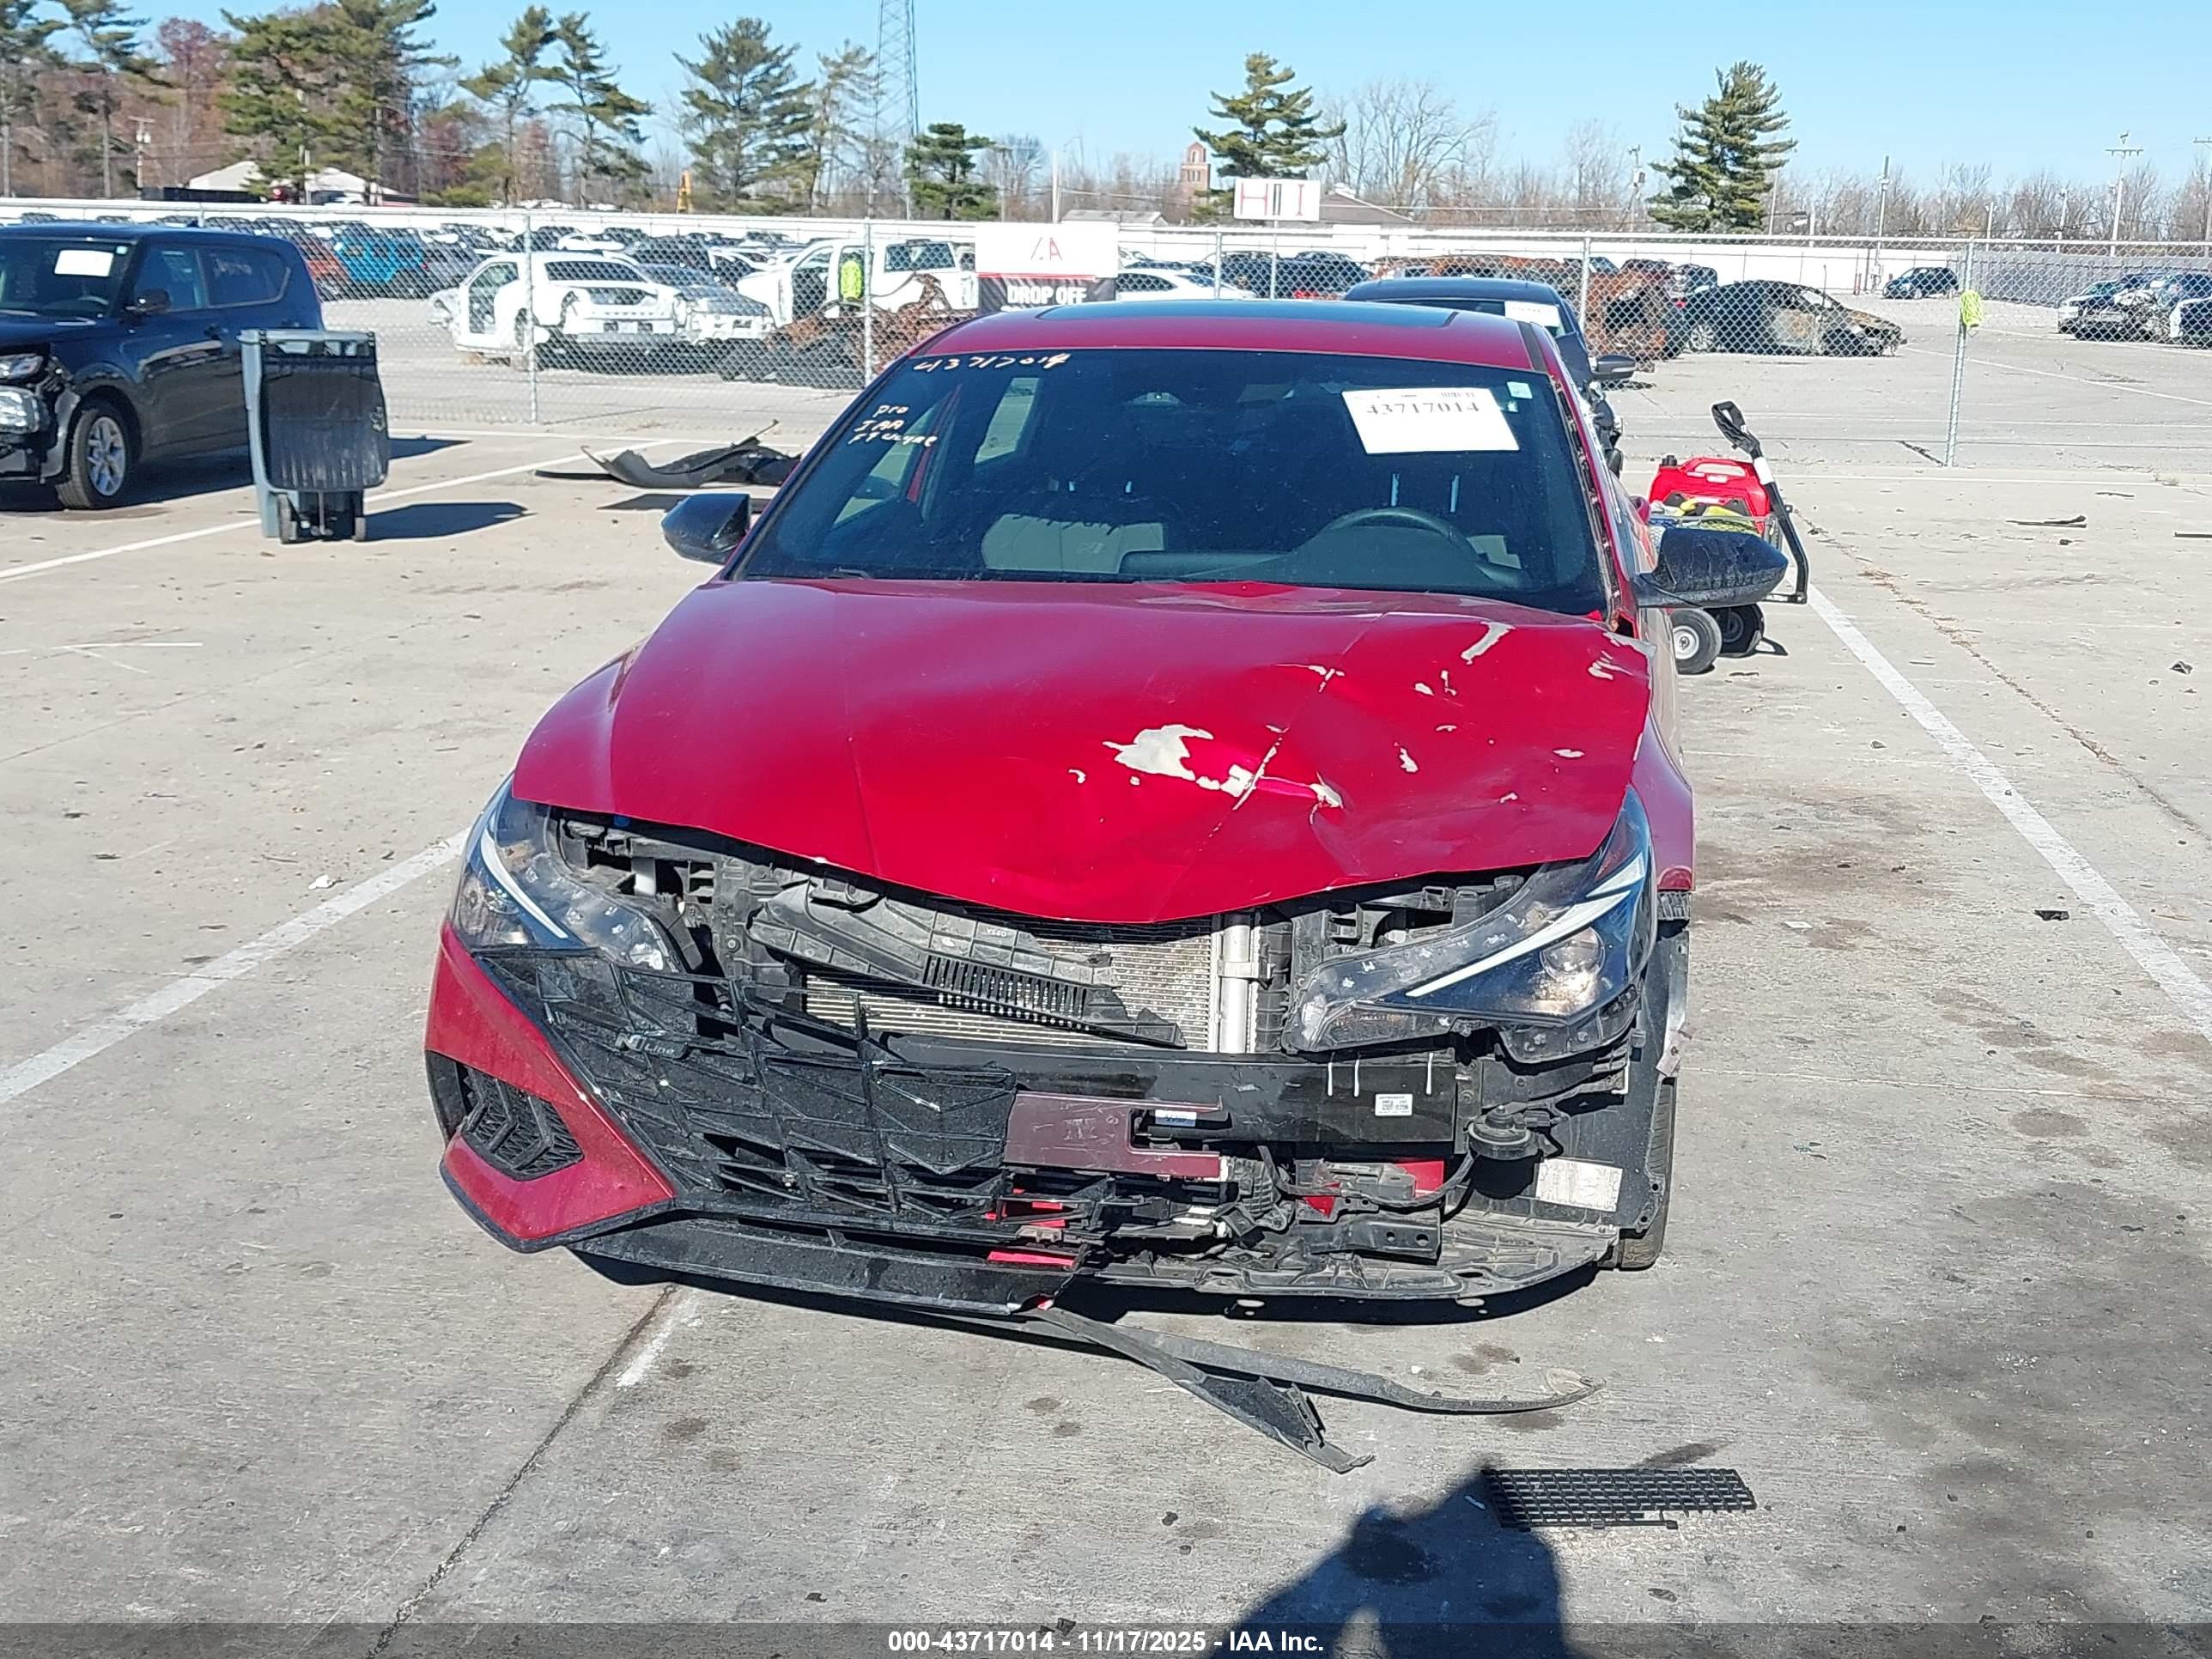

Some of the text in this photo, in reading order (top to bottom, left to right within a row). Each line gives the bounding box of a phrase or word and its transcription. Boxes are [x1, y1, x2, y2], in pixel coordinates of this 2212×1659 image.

[1007, 285, 1087, 305] DROP OFF
[914, 353, 1071, 372] 43717014
[1366, 402, 1480, 415] 43717014
